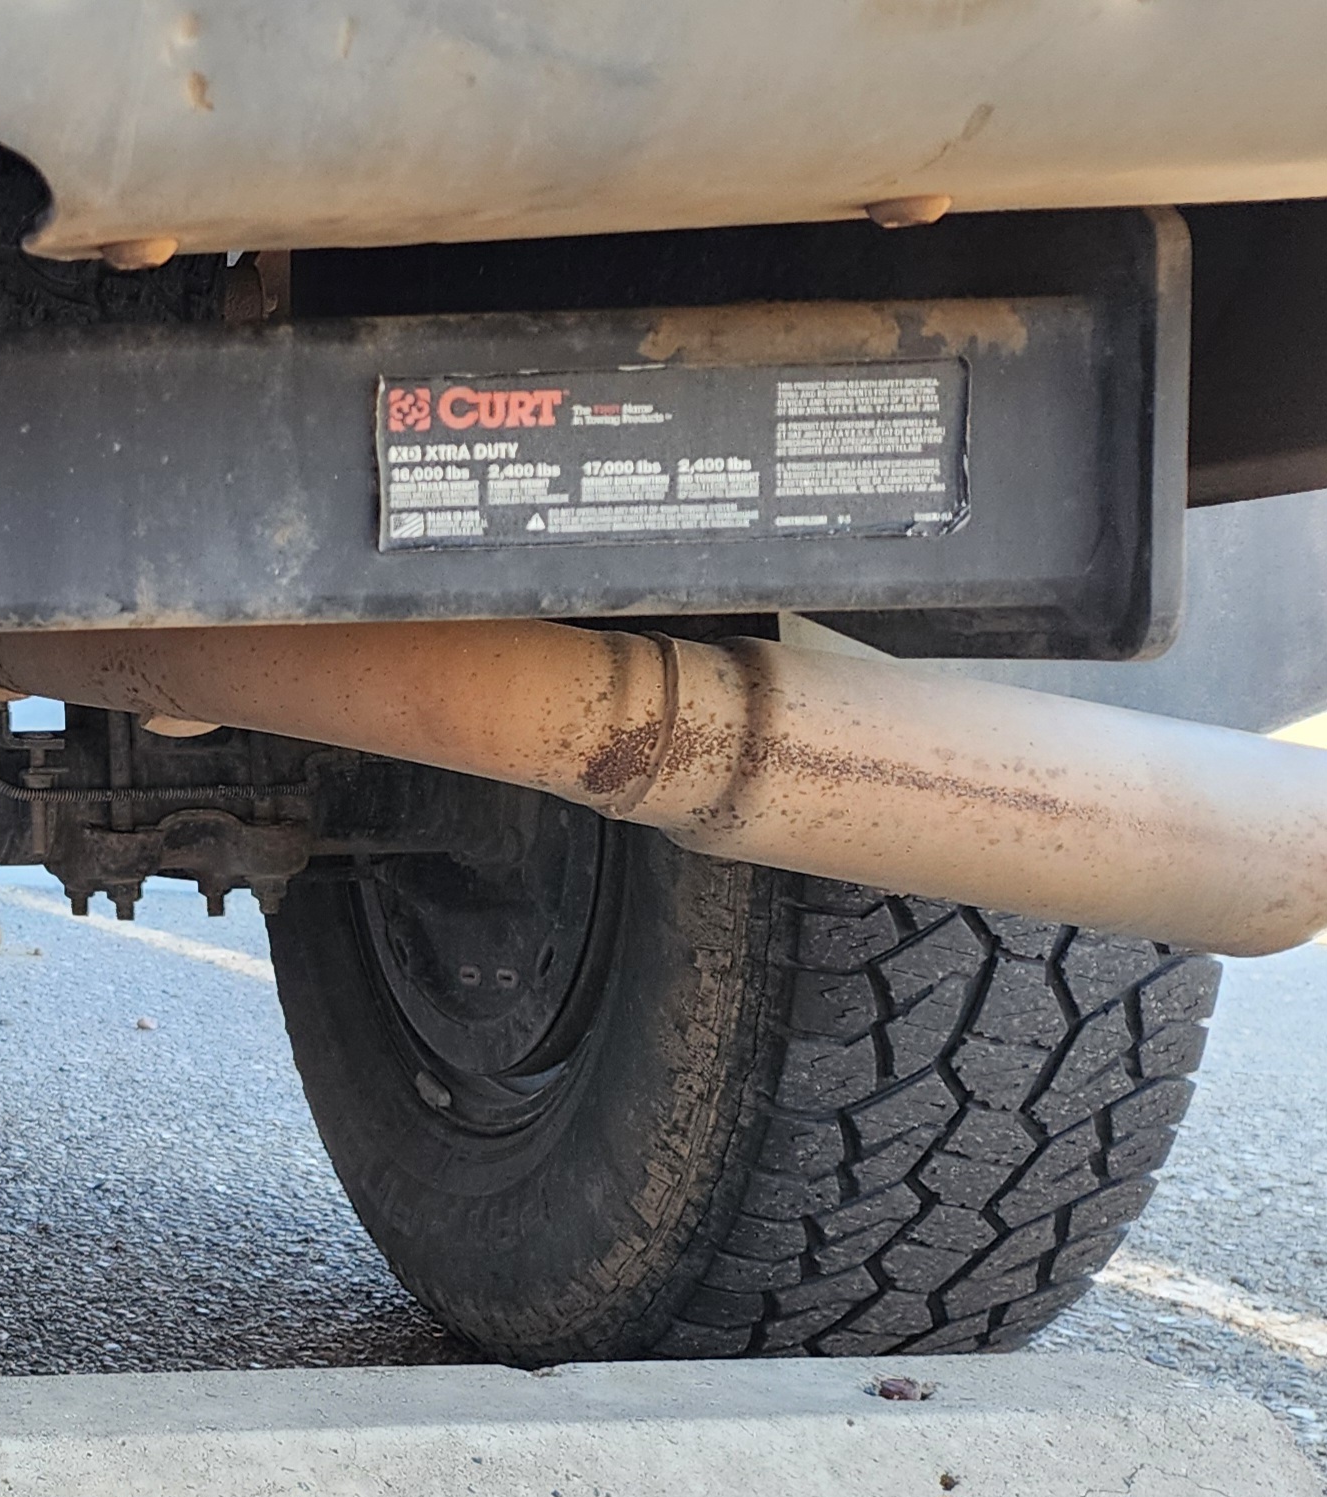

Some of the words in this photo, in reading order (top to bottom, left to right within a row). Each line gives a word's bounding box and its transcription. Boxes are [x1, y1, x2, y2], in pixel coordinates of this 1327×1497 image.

[437, 386, 562, 429] CURT
[424, 444, 471, 461] XTRA
[474, 442, 518, 460] DUTY
[446, 464, 469, 480] lbs
[487, 464, 534, 480] 2,400
[536, 462, 561, 477] lbs
[582, 460, 634, 477] 17,000
[636, 459, 661, 474] lbs
[726, 456, 752, 471] lbs
